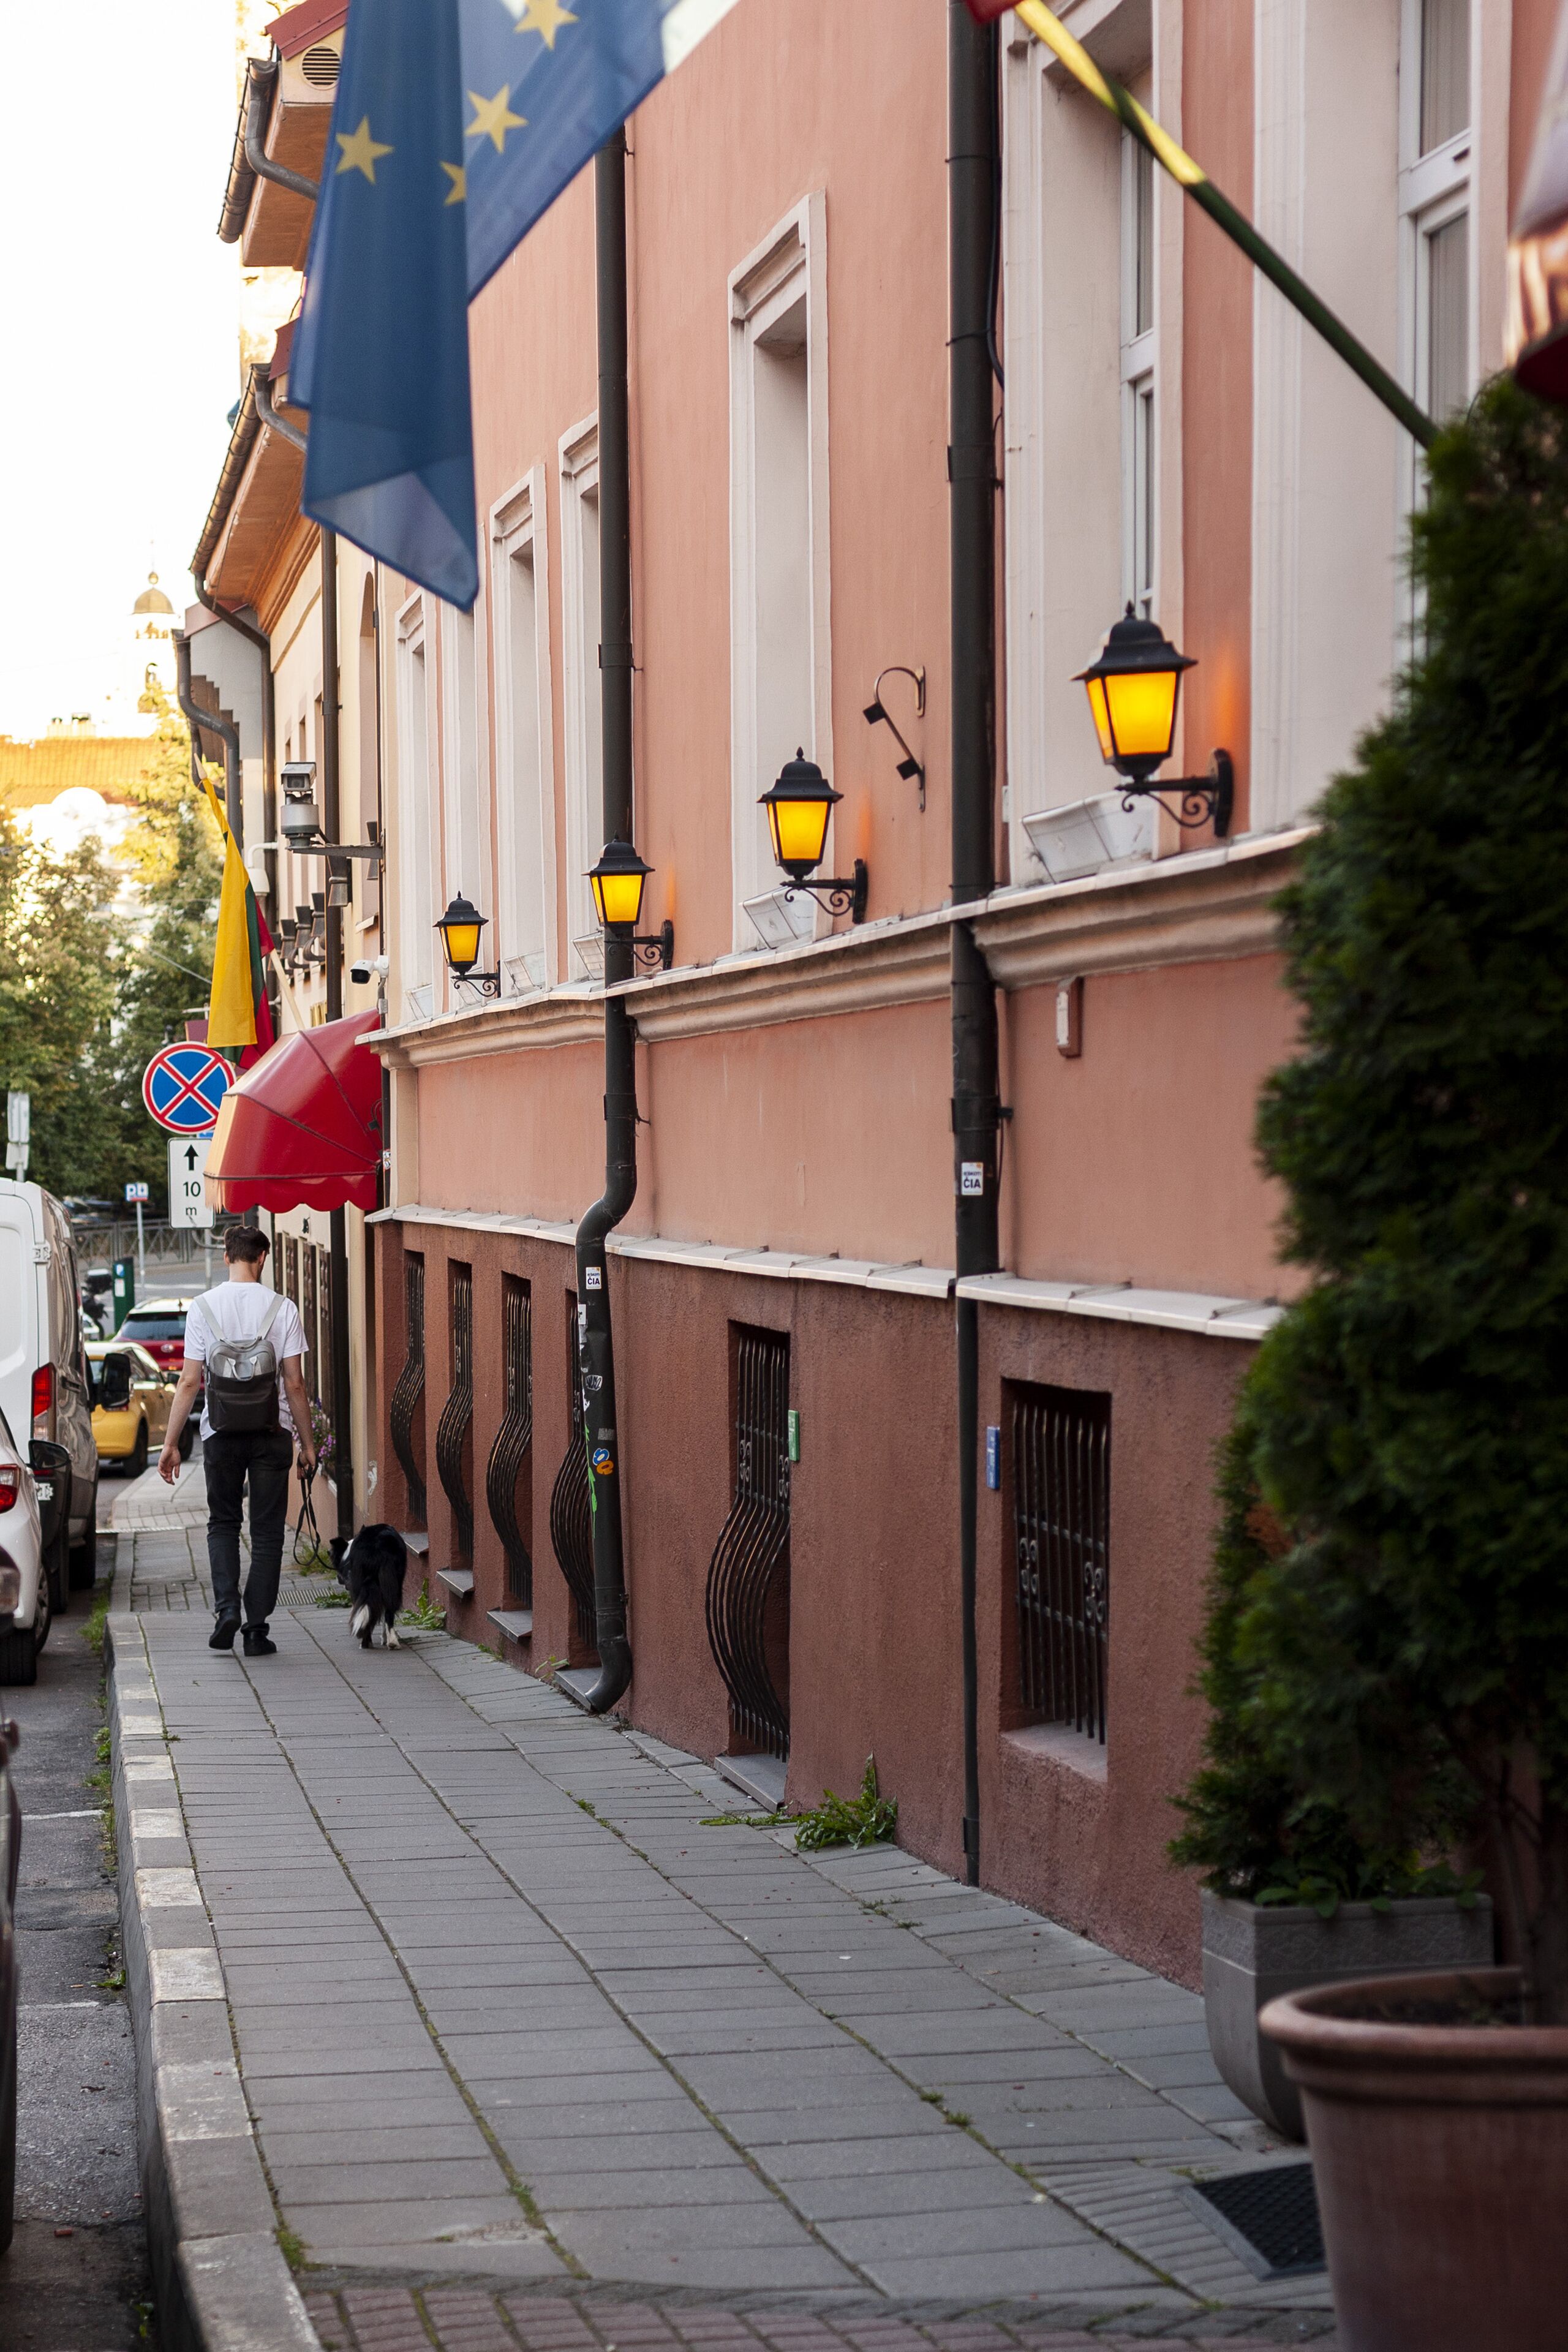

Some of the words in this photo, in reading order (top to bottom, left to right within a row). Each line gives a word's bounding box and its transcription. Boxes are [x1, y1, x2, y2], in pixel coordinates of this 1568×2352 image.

[963, 1177, 981, 1188] ČIA
[183, 1182, 201, 1197] 10
[186, 1207, 197, 1215] m
